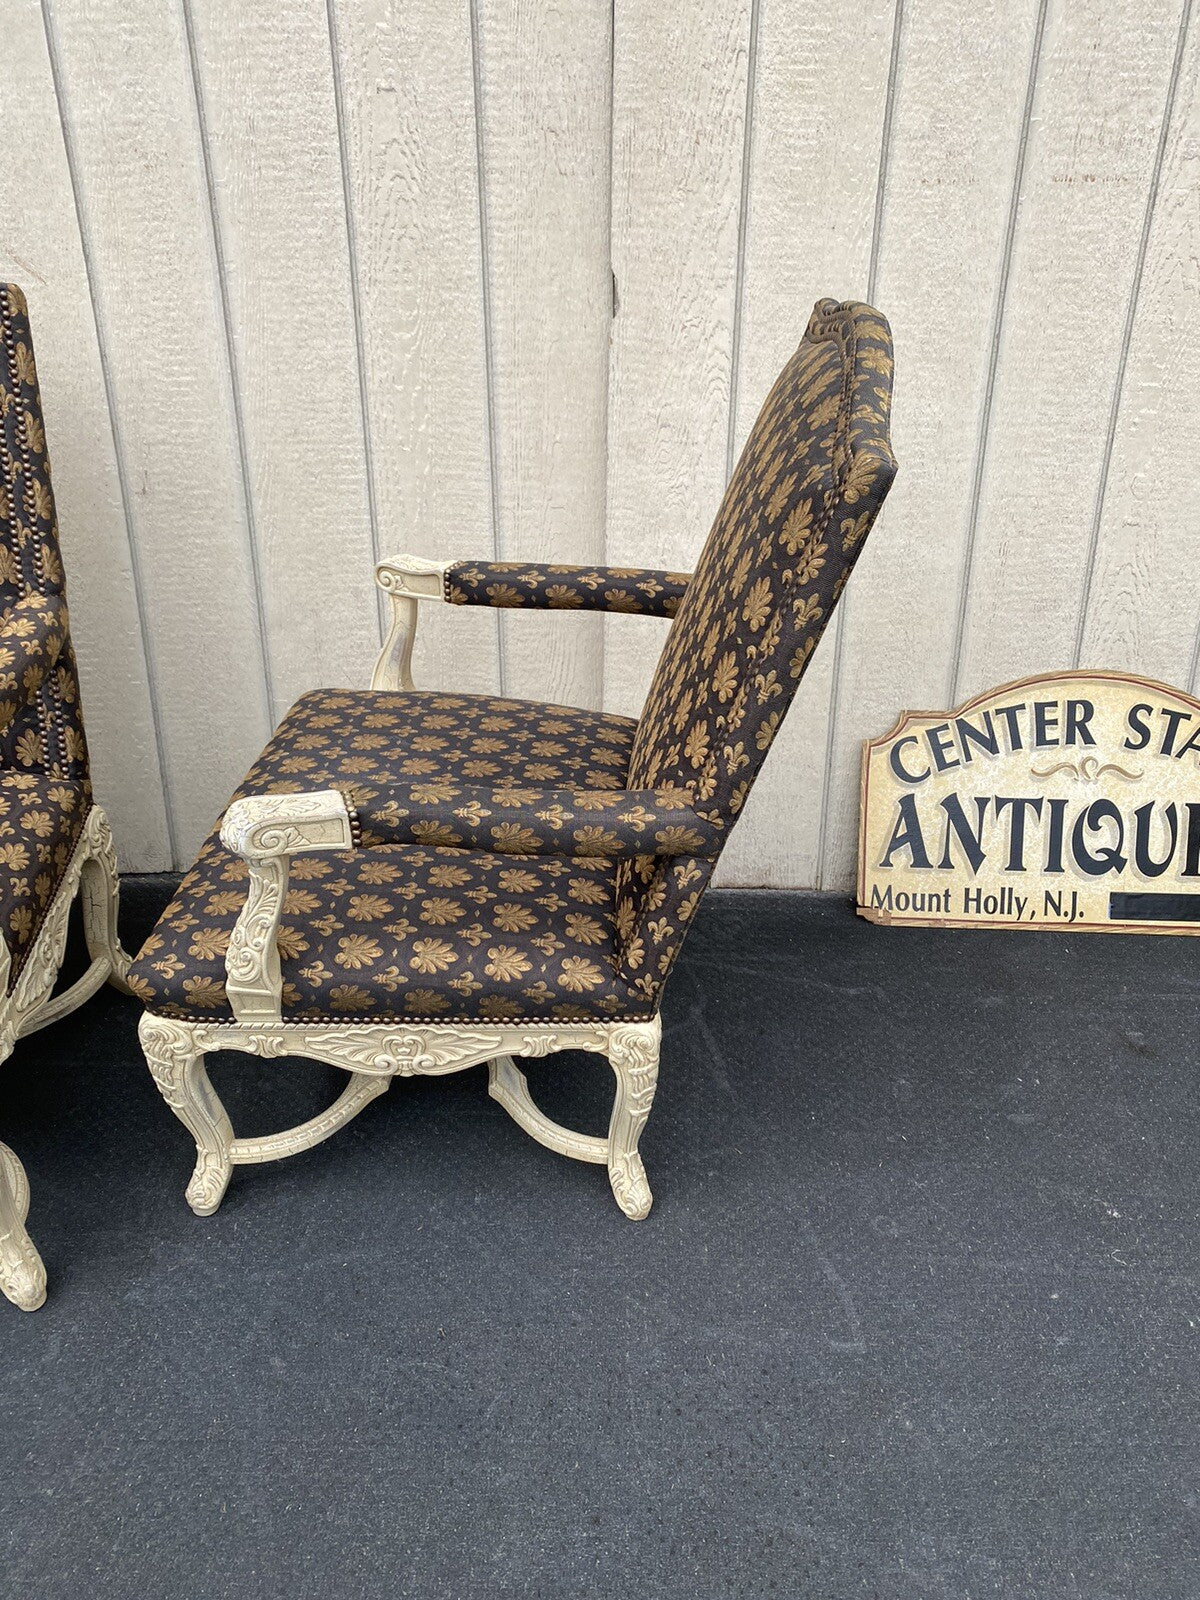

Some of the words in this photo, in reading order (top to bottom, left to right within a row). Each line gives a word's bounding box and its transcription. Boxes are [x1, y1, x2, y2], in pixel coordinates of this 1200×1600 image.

[889, 699, 1097, 784] CENTER
[870, 884, 952, 912] Mount
[963, 887, 1036, 920] Holly,
[1043, 889, 1085, 923] N.J.
